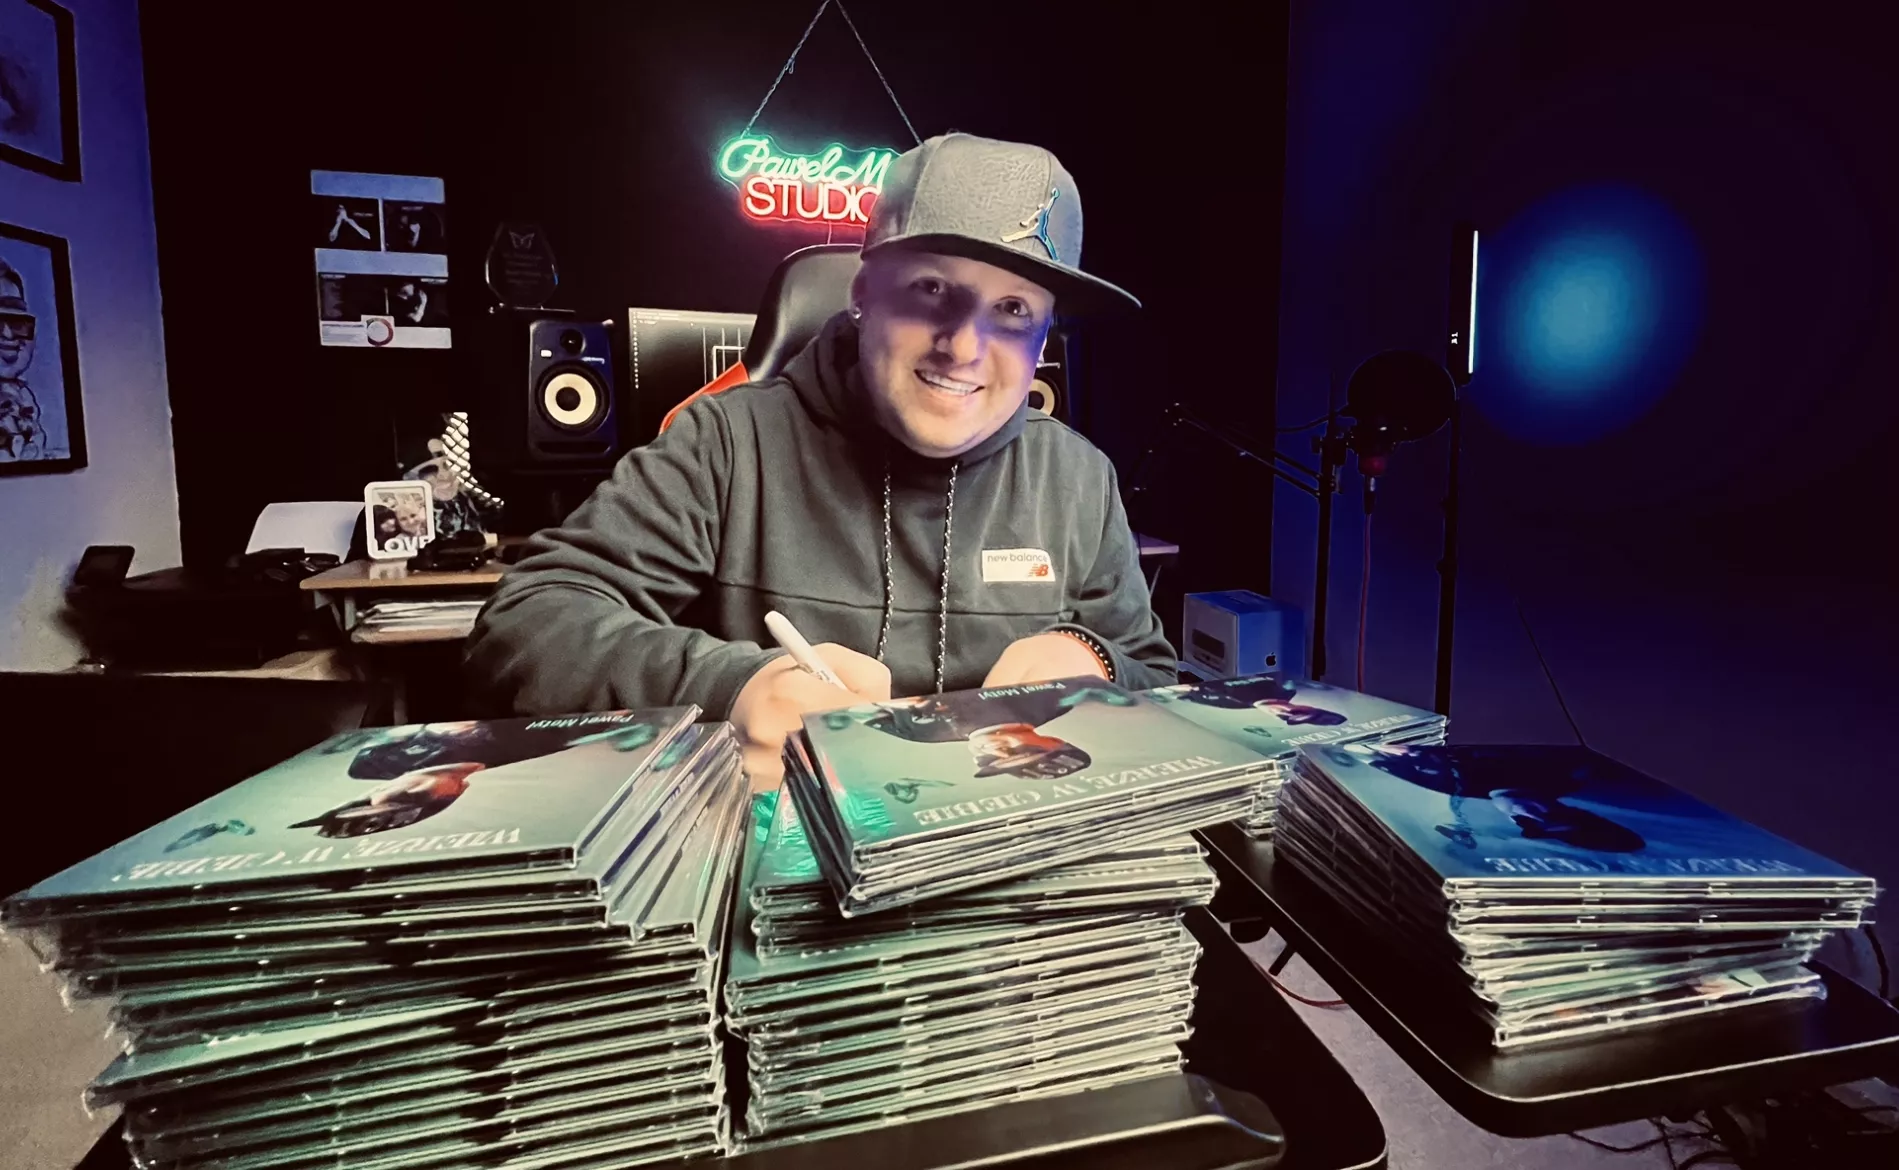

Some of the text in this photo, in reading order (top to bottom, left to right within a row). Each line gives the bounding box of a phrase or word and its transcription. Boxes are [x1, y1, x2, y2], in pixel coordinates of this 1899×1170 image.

[832, 151, 892, 196] M
[912, 790, 1043, 826] CIEBIE
[1051, 781, 1090, 800] W
